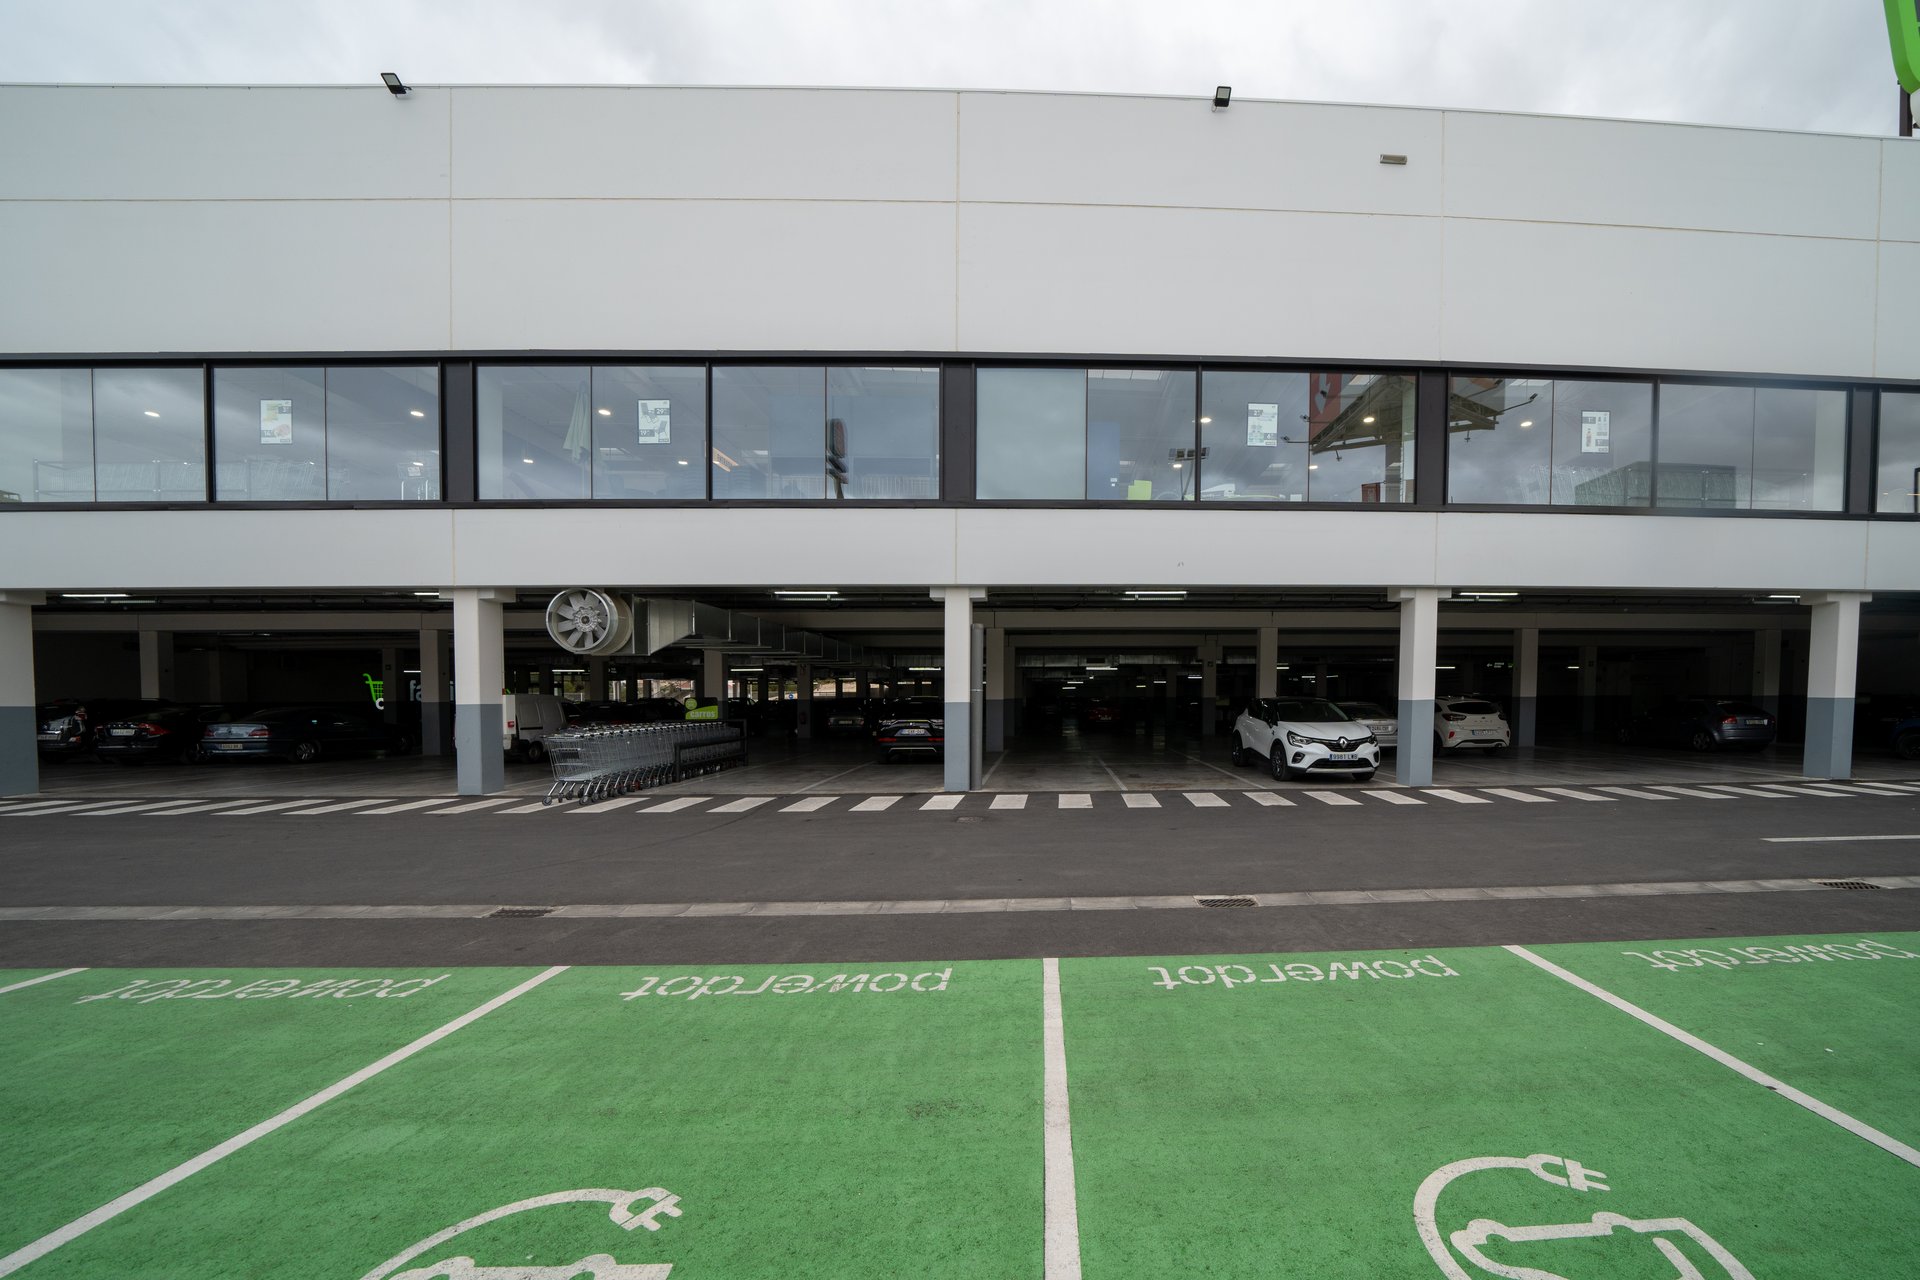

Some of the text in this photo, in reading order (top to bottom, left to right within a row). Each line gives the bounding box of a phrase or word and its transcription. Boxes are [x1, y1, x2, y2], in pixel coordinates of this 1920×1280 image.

[1153, 954, 1459, 990] powerdot
[1621, 939, 1920, 972] powerdot
[73, 974, 452, 1004] powerdot
[621, 967, 953, 1001] powerdot
